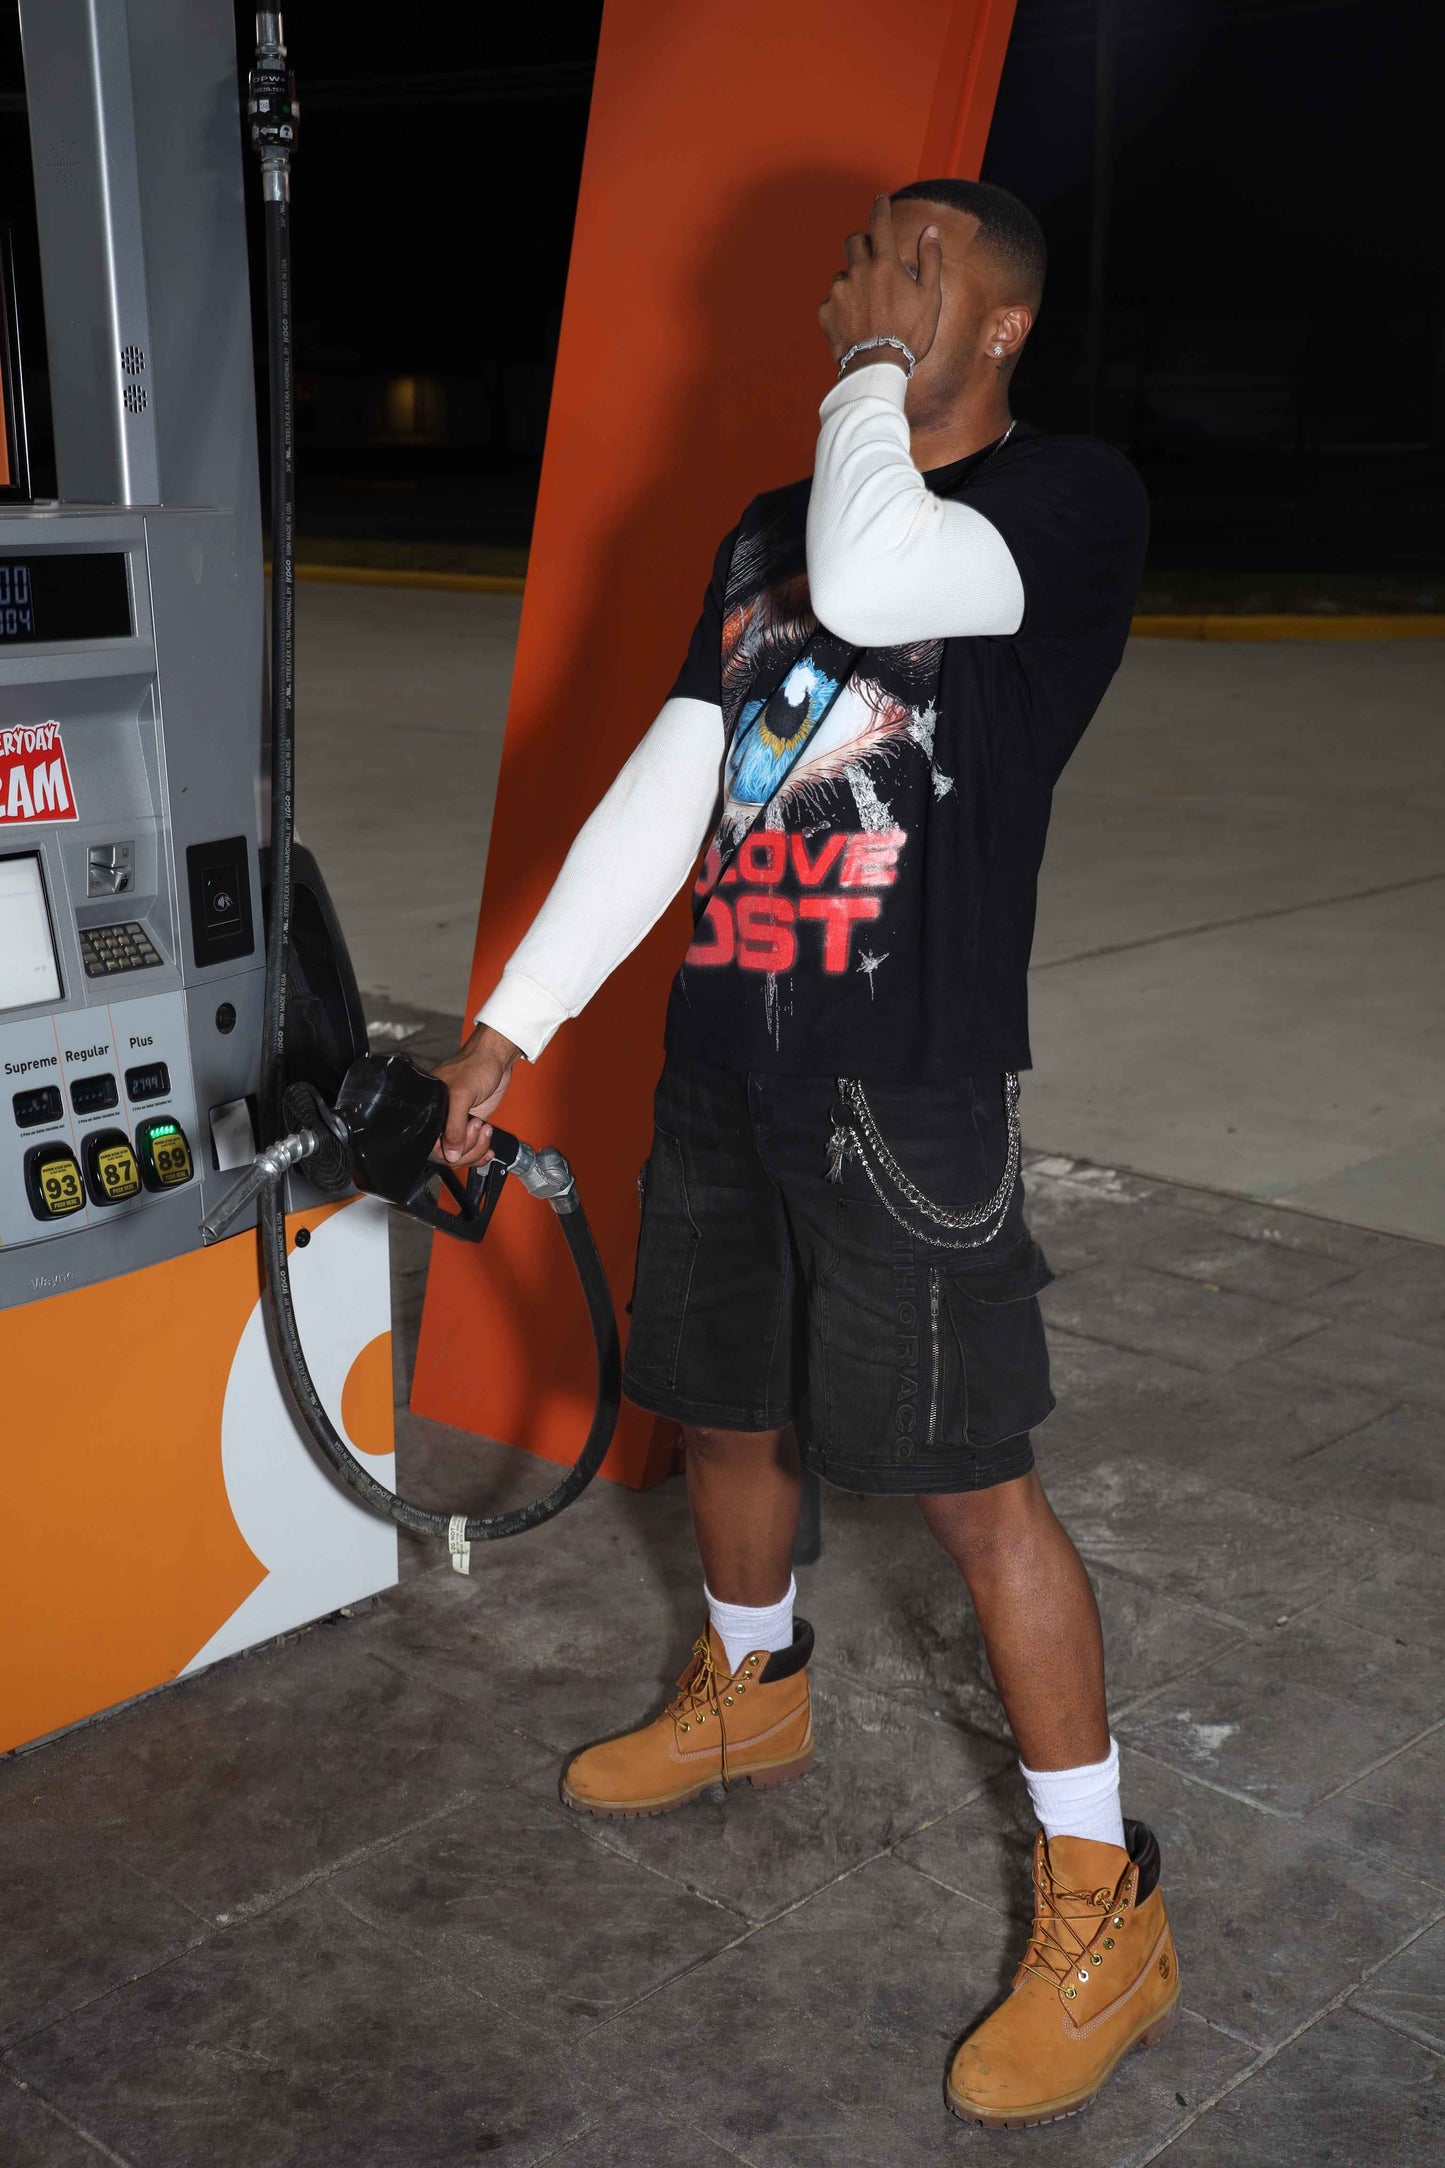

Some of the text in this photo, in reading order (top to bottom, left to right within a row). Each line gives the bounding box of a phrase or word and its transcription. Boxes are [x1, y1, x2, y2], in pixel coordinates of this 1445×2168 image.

[284, 346, 290, 355] BY
[0, 608, 31, 635] 04
[286, 821, 291, 830] BY
[720, 829, 907, 887] OVE
[129, 1036, 153, 1049] Plus
[65, 1044, 110, 1063] Regular
[4, 1056, 58, 1076] Supreme
[157, 1148, 186, 1171] 89
[105, 1160, 130, 1185] 87
[46, 1174, 78, 1199] 93
[284, 1297, 290, 1306] BY
[286, 1307, 297, 1339] HARDWALL
[292, 1339, 301, 1359] ULTRA
